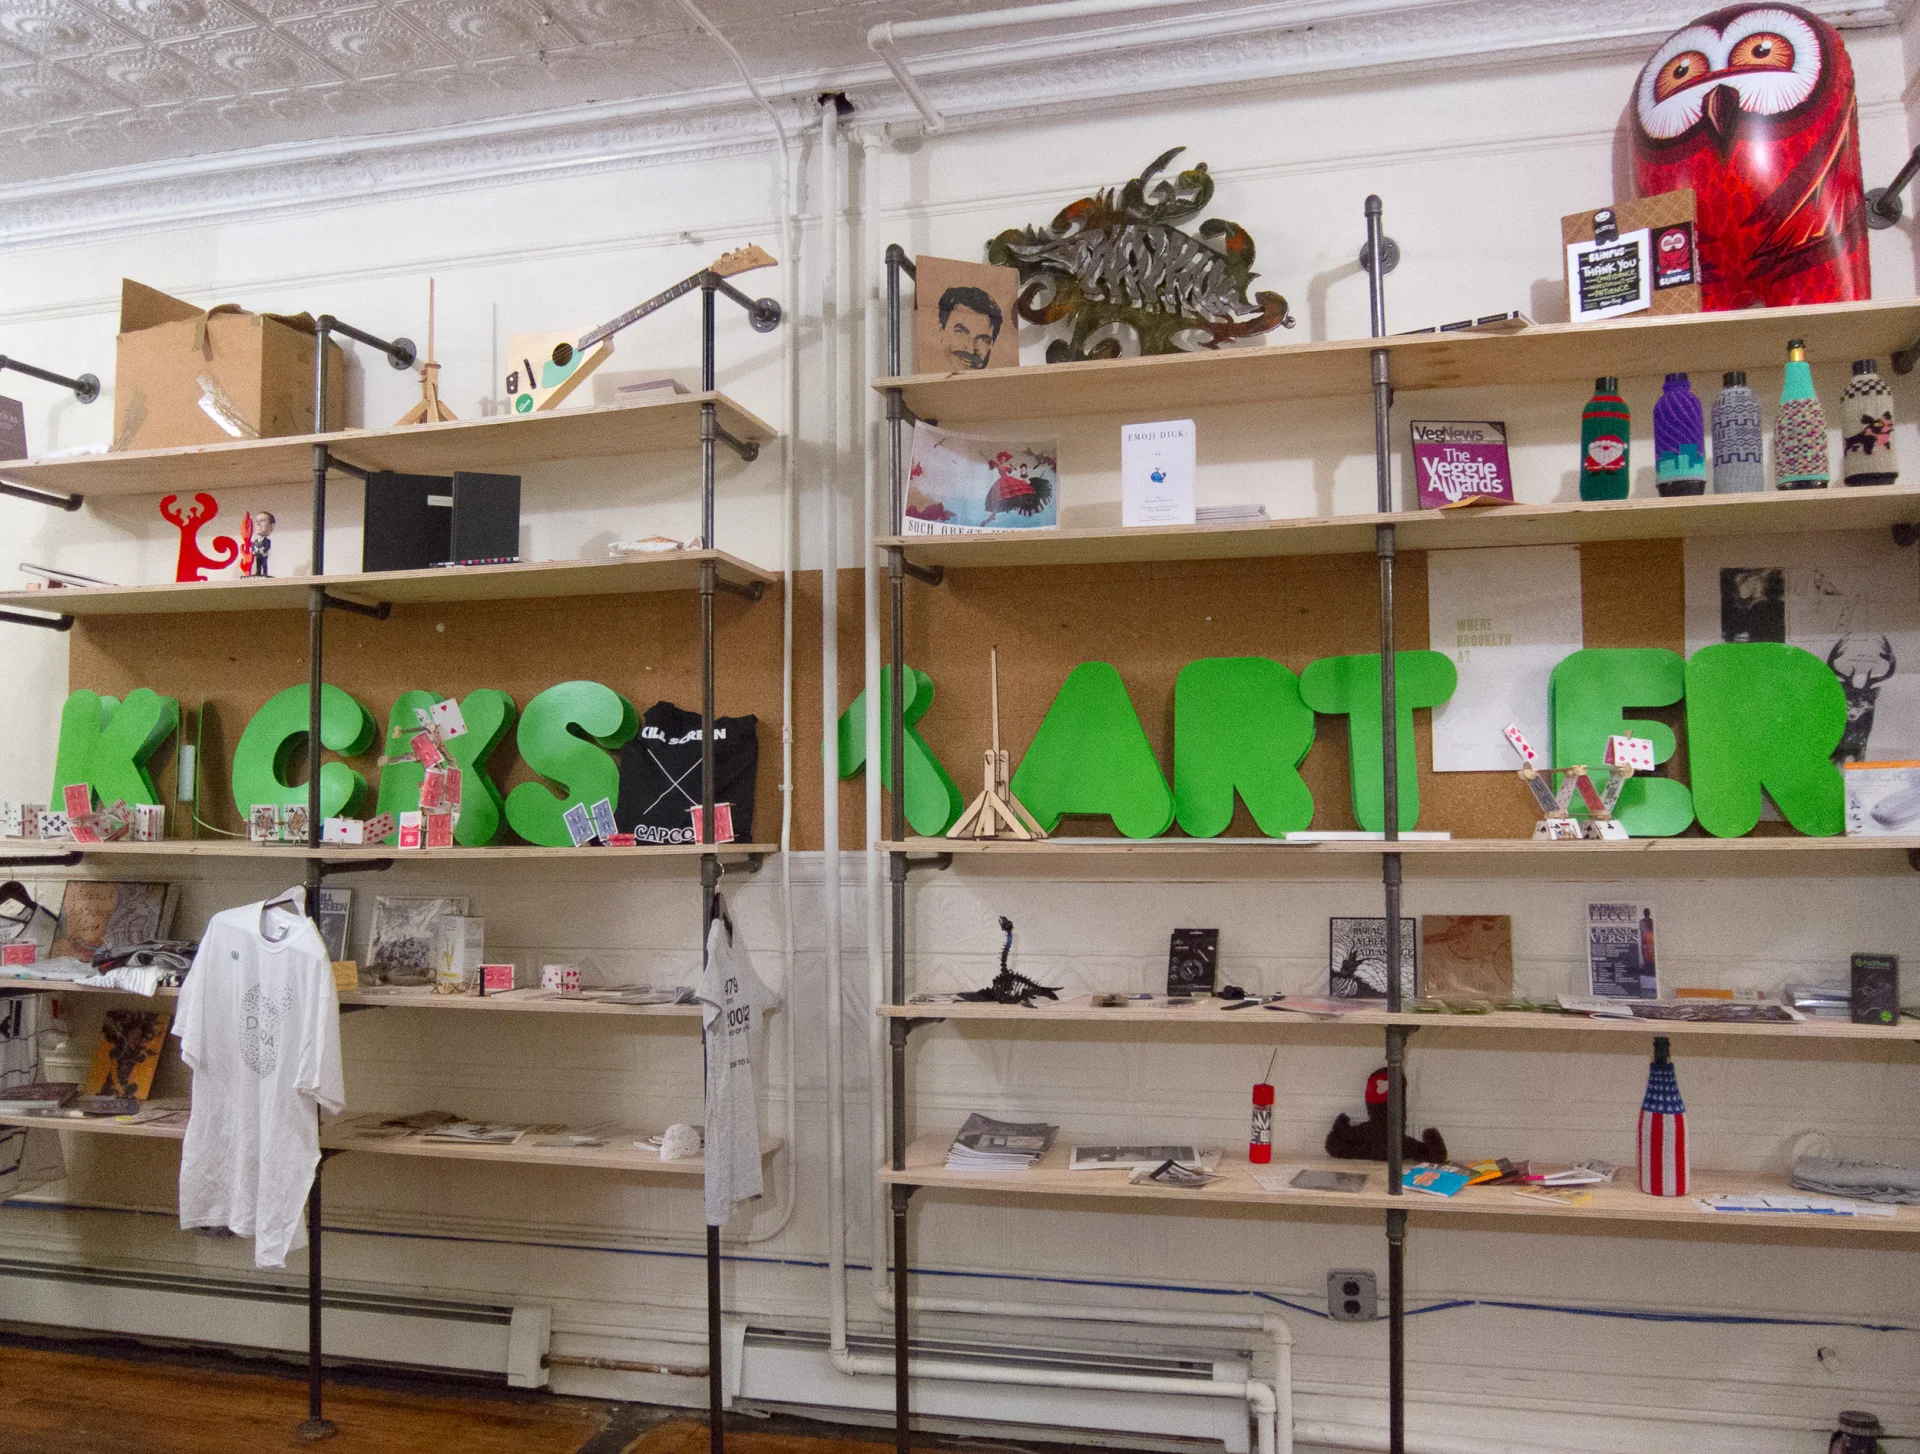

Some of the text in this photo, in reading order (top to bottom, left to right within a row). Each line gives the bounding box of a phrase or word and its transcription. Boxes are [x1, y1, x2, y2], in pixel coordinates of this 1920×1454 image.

[1581, 258, 1637, 277] THANK YOU
[1128, 433, 1156, 441] EMOJI
[1415, 426, 1484, 443] VegNews
[1443, 448, 1470, 462] The
[1422, 457, 1497, 482] Veggie
[1428, 473, 1504, 502] Awards
[908, 519, 934, 535] SUCH
[668, 728, 727, 745] SCREN
[634, 824, 695, 844] CAPCO
[1590, 934, 1640, 944] VERSES
